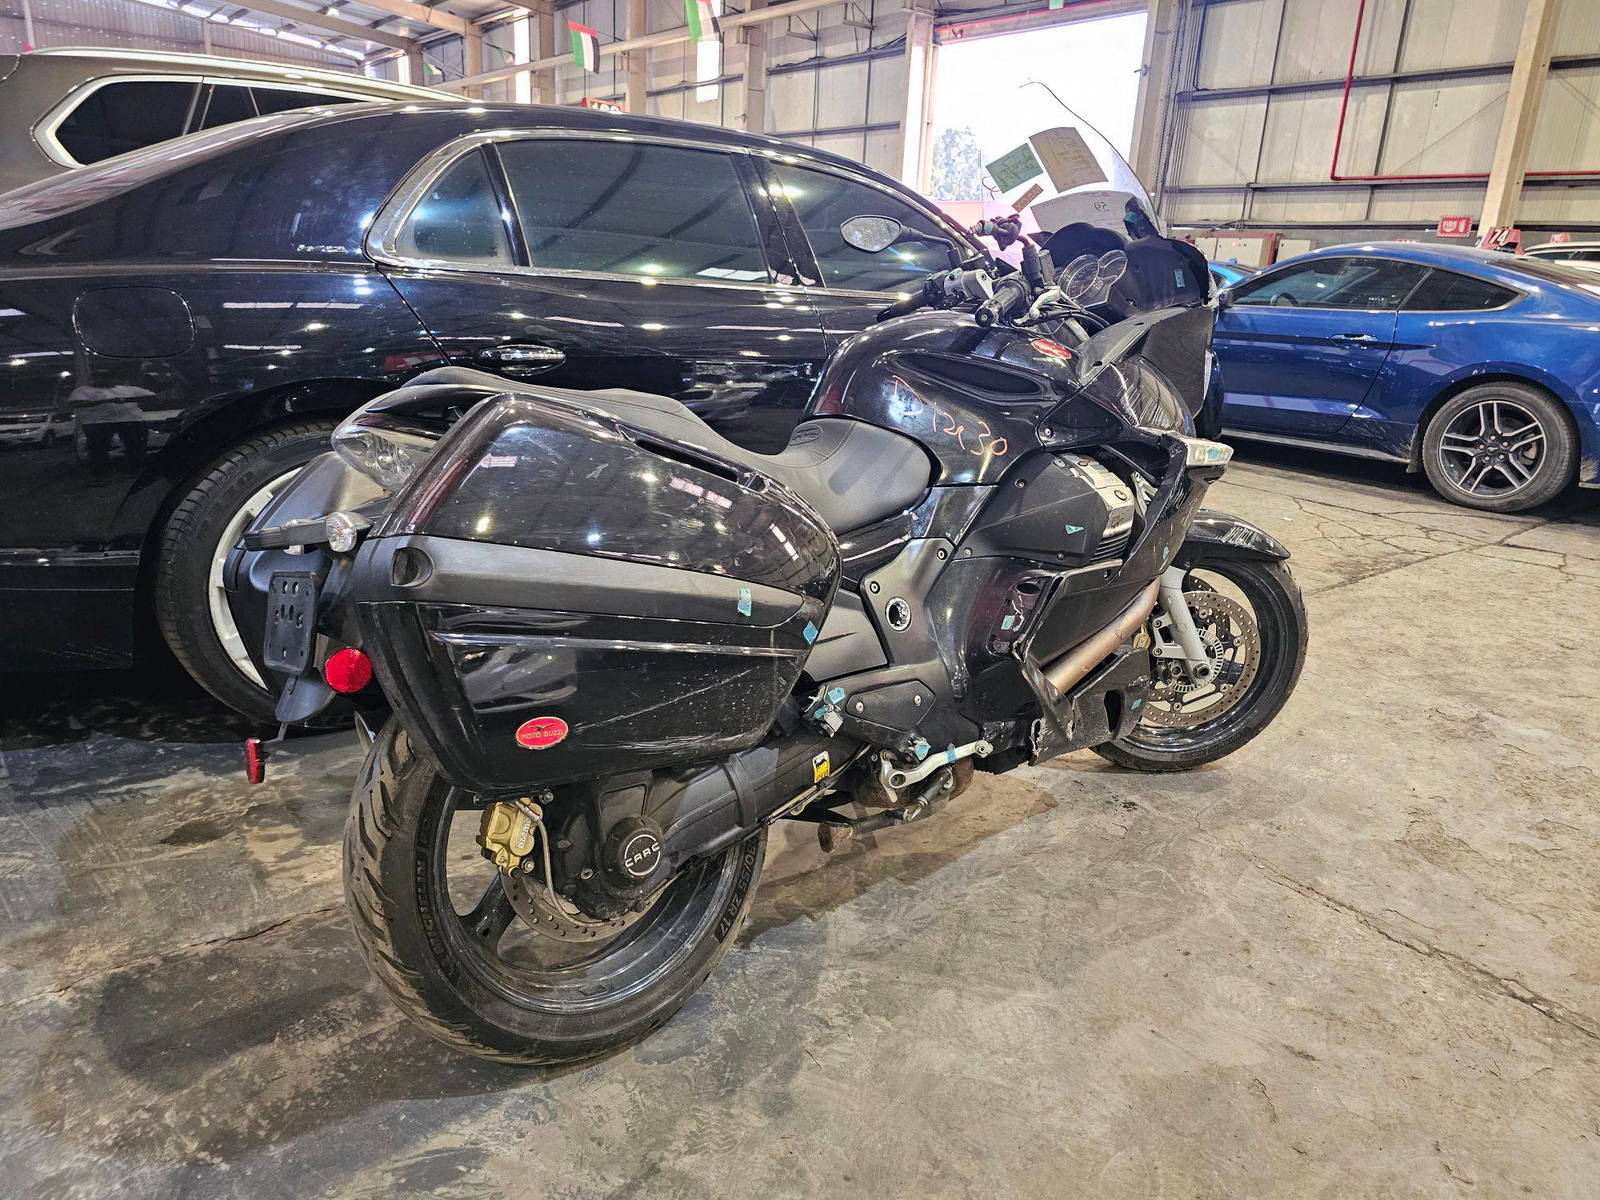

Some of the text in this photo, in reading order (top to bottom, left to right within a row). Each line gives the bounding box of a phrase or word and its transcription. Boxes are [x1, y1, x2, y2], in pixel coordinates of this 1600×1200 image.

[1489, 228, 1510, 246] 74
[521, 729, 564, 740] MOTO GUZZI
[625, 842, 660, 868] CARC
[719, 918, 733, 937] 17
